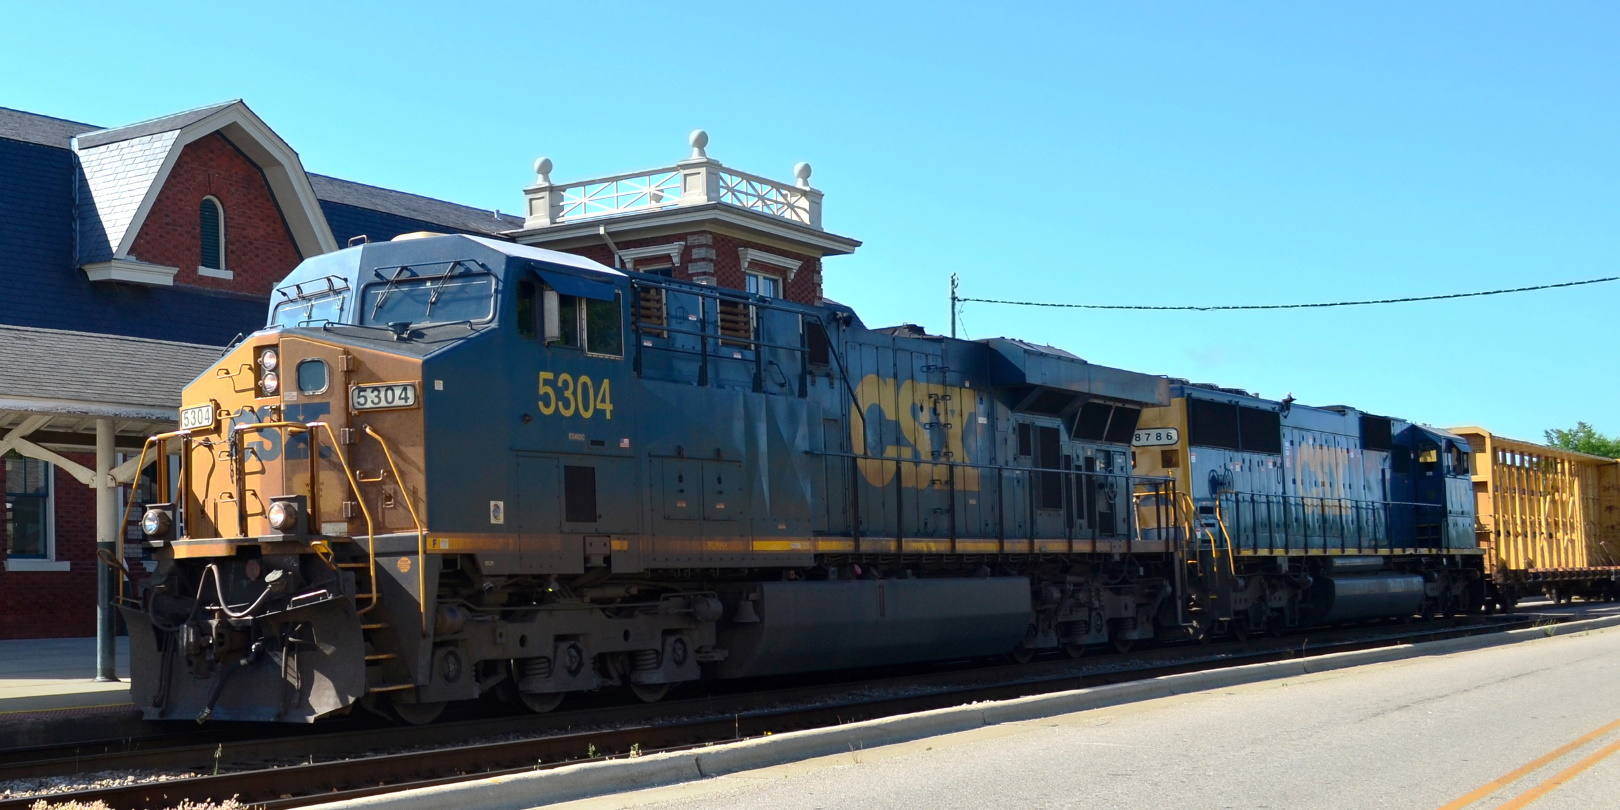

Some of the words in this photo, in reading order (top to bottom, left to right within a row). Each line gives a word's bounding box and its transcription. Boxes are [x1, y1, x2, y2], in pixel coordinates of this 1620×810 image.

[356, 386, 410, 406] 5304
[538, 371, 613, 420] 5304
[183, 408, 211, 427] 5304
[228, 402, 331, 462] CSX
[850, 374, 980, 491] CSX
[1134, 432, 1173, 442] 8786
[432, 538, 437, 548] F
